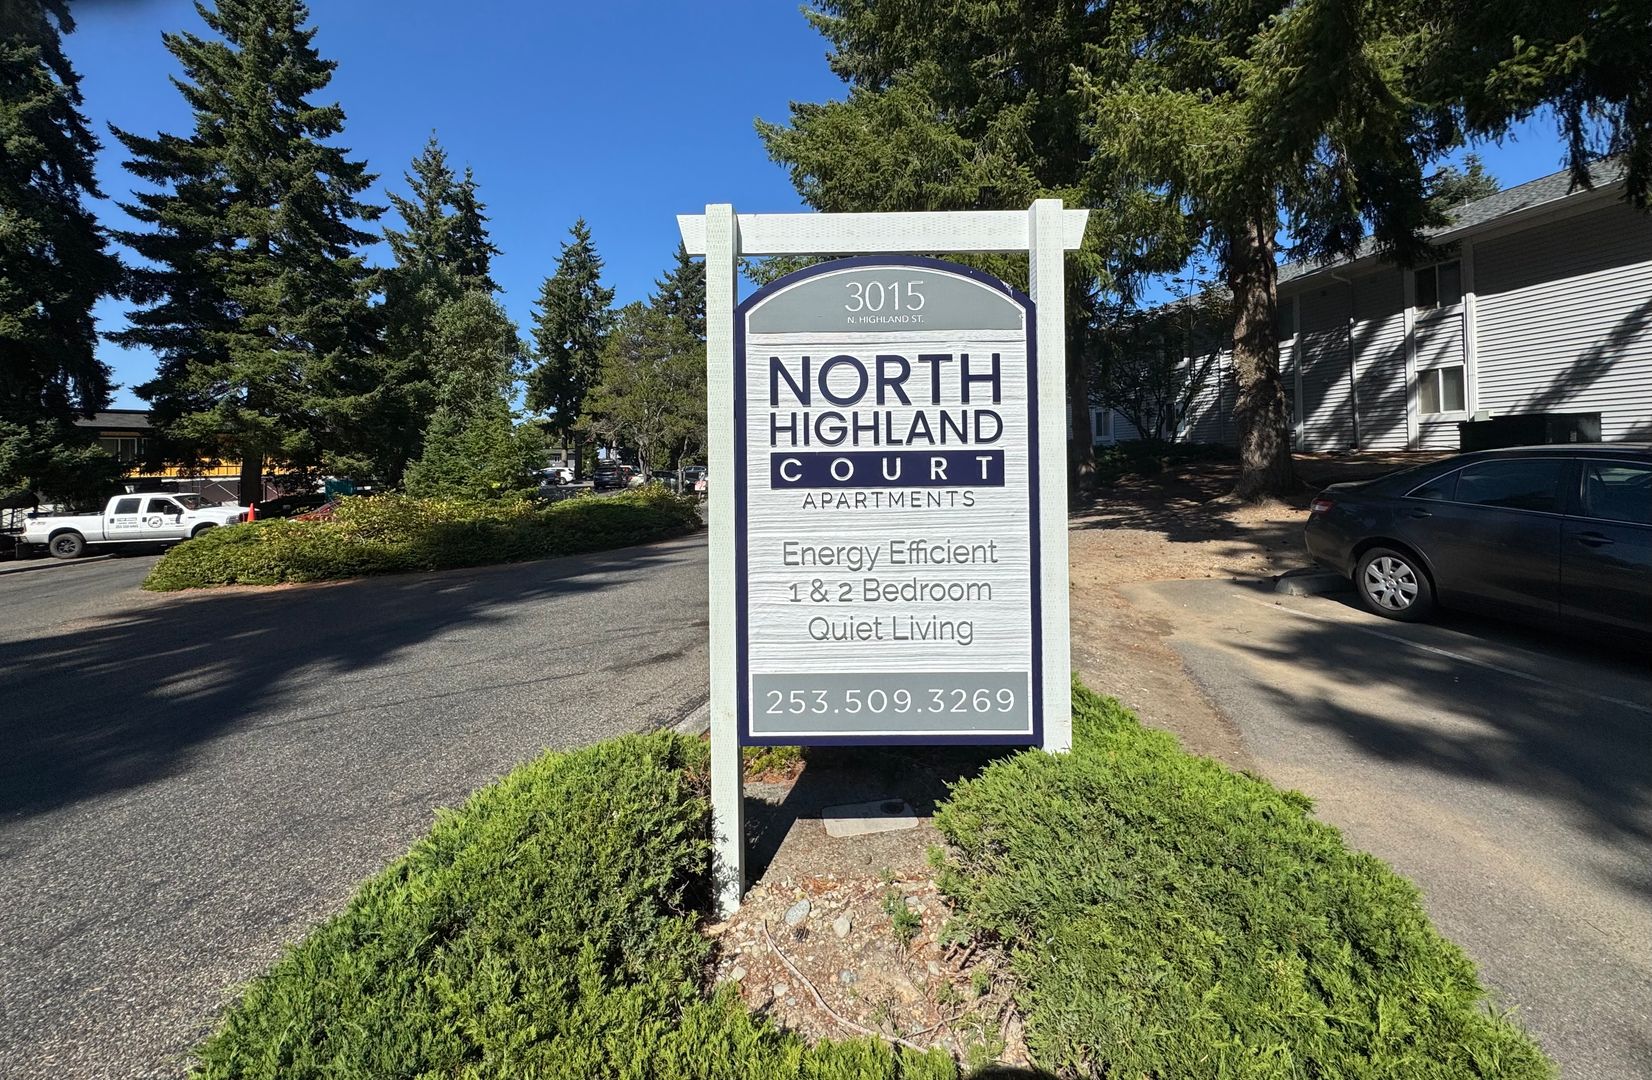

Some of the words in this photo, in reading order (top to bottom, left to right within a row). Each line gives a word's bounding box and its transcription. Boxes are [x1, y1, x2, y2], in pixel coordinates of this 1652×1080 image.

[844, 280, 925, 312] 3015
[859, 315, 909, 323] HIGHLAND
[911, 315, 924, 323] ST.
[769, 353, 1000, 408] NORTH
[770, 409, 1003, 447] HIGHLAND
[779, 456, 993, 482] COURT
[802, 490, 975, 509] APARTMENTS
[783, 541, 880, 572] Energy
[889, 539, 998, 564] Efficient
[788, 584, 801, 602] 1
[810, 579, 829, 602] &
[838, 583, 853, 602] 2
[863, 578, 992, 602] Bedroom
[808, 616, 883, 641] Quiet
[893, 615, 973, 645] Living
[766, 688, 1015, 714] 253.509.3269
